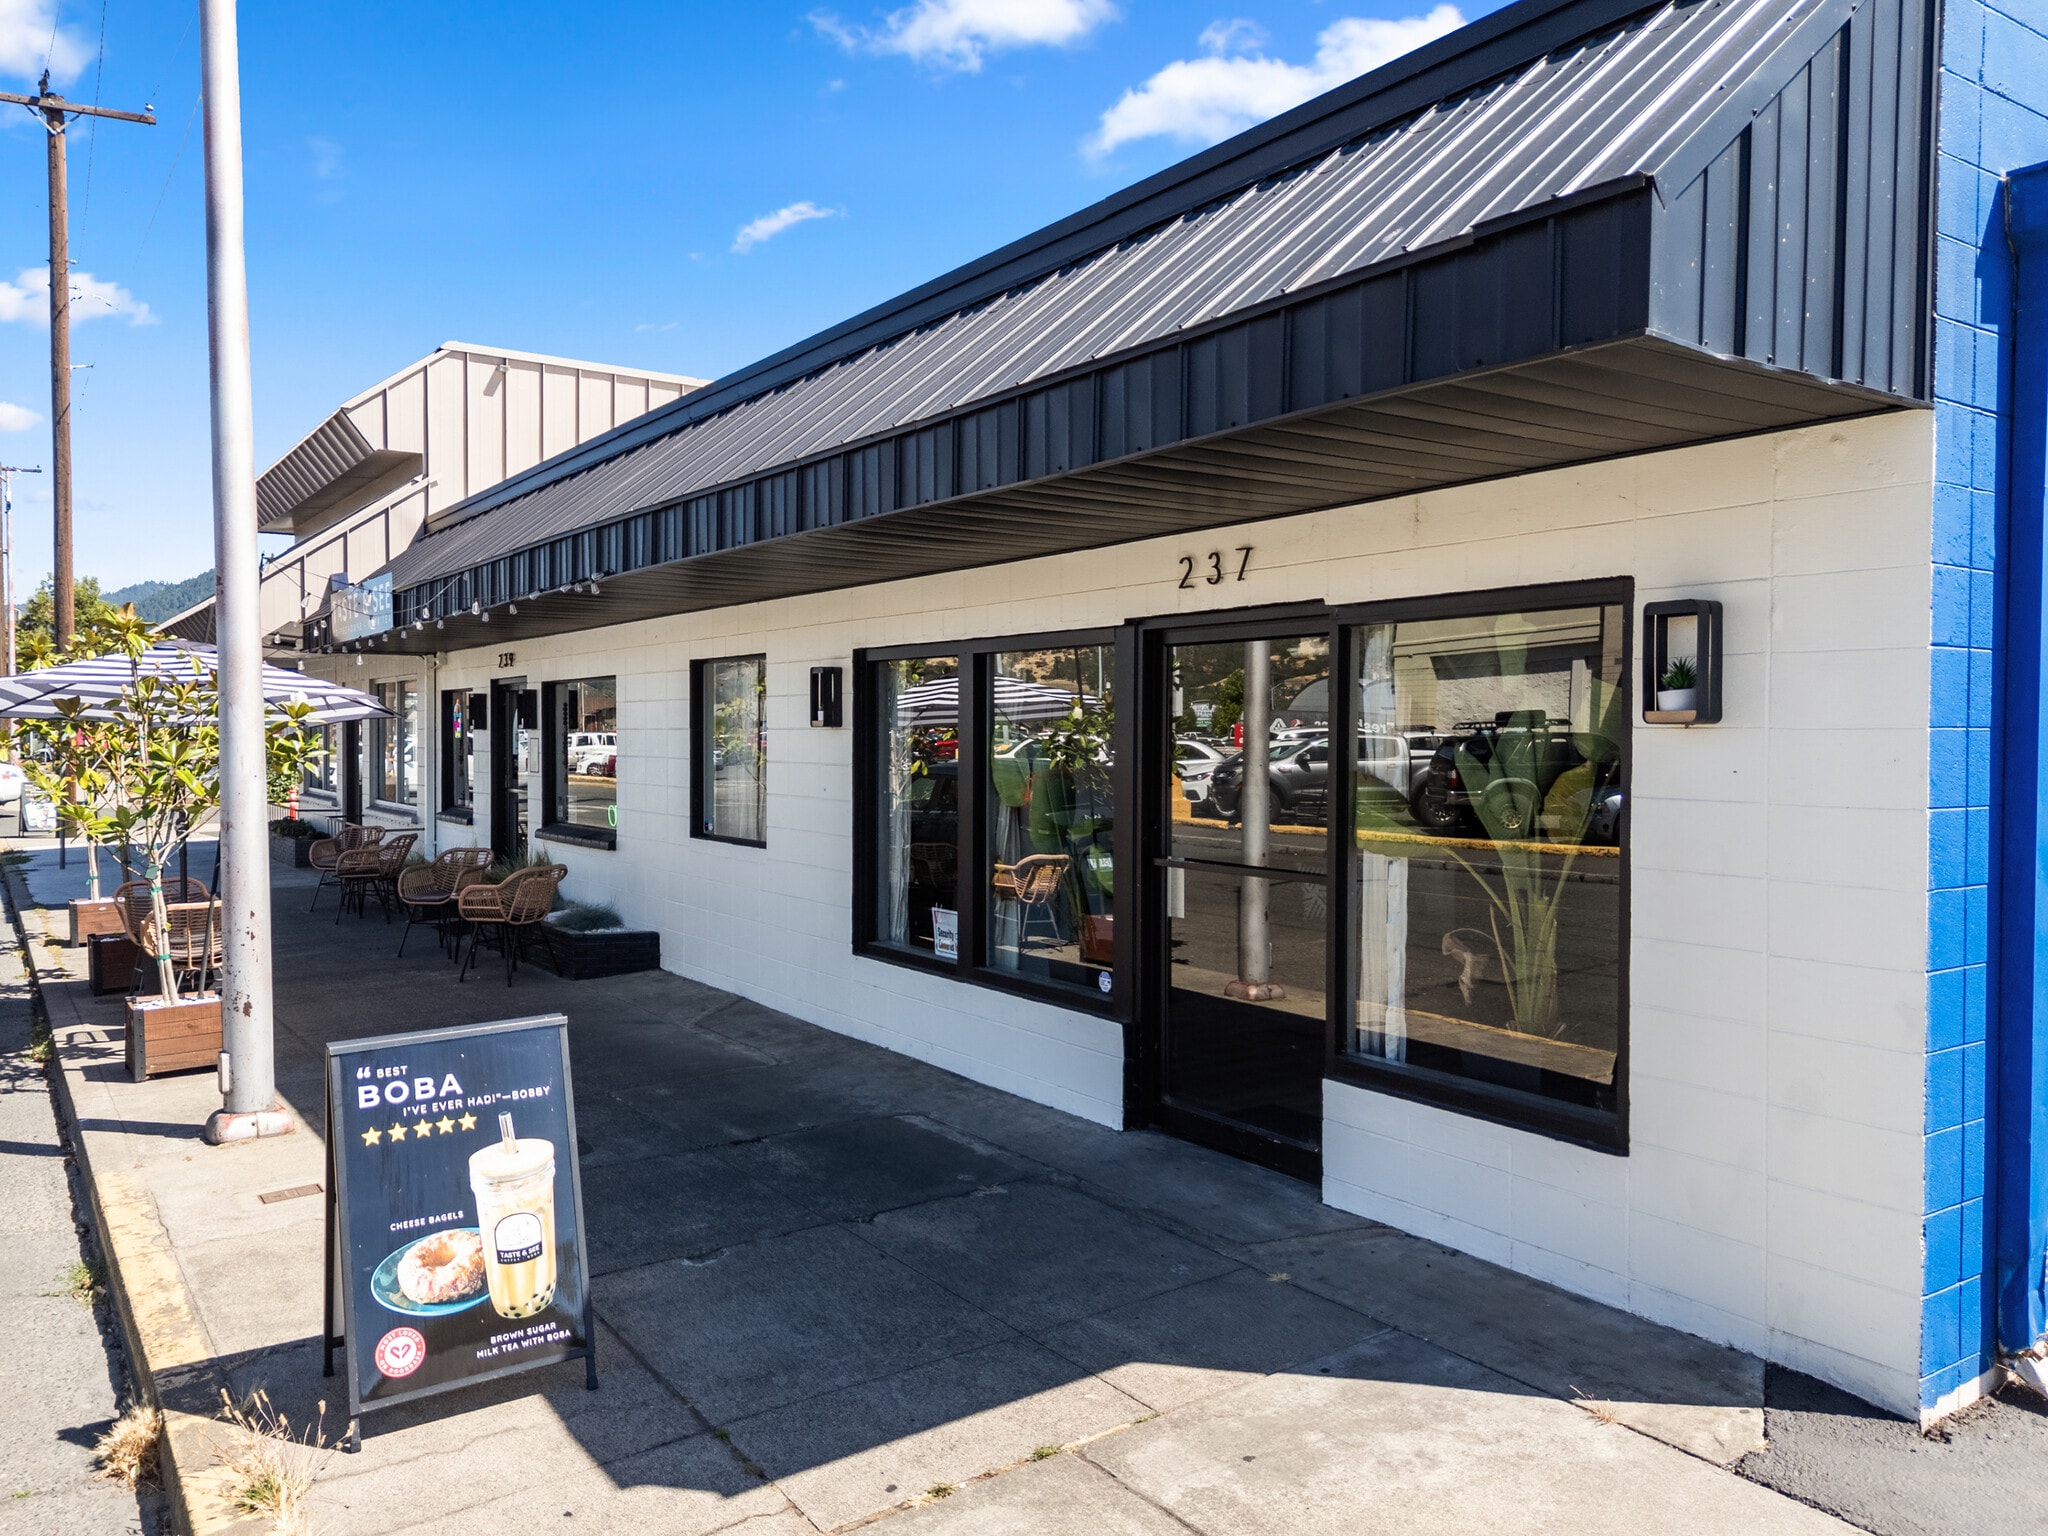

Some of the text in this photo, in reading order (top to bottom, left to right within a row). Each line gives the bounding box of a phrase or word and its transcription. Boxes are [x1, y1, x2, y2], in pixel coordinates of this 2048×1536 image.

[1178, 546, 1254, 589] 237
[373, 582, 390, 612] SEE
[498, 652, 514, 669] 239
[376, 1065, 408, 1079] BEST
[357, 1073, 464, 1110] BOBA
[432, 1099, 463, 1113] EVER
[389, 1210, 464, 1231] CHEESE BAGELS
[500, 1250, 521, 1259] TASTE
[490, 1321, 557, 1344] BROWN SUGAR
[476, 1329, 571, 1359] MILK TEA WITH BOBA
